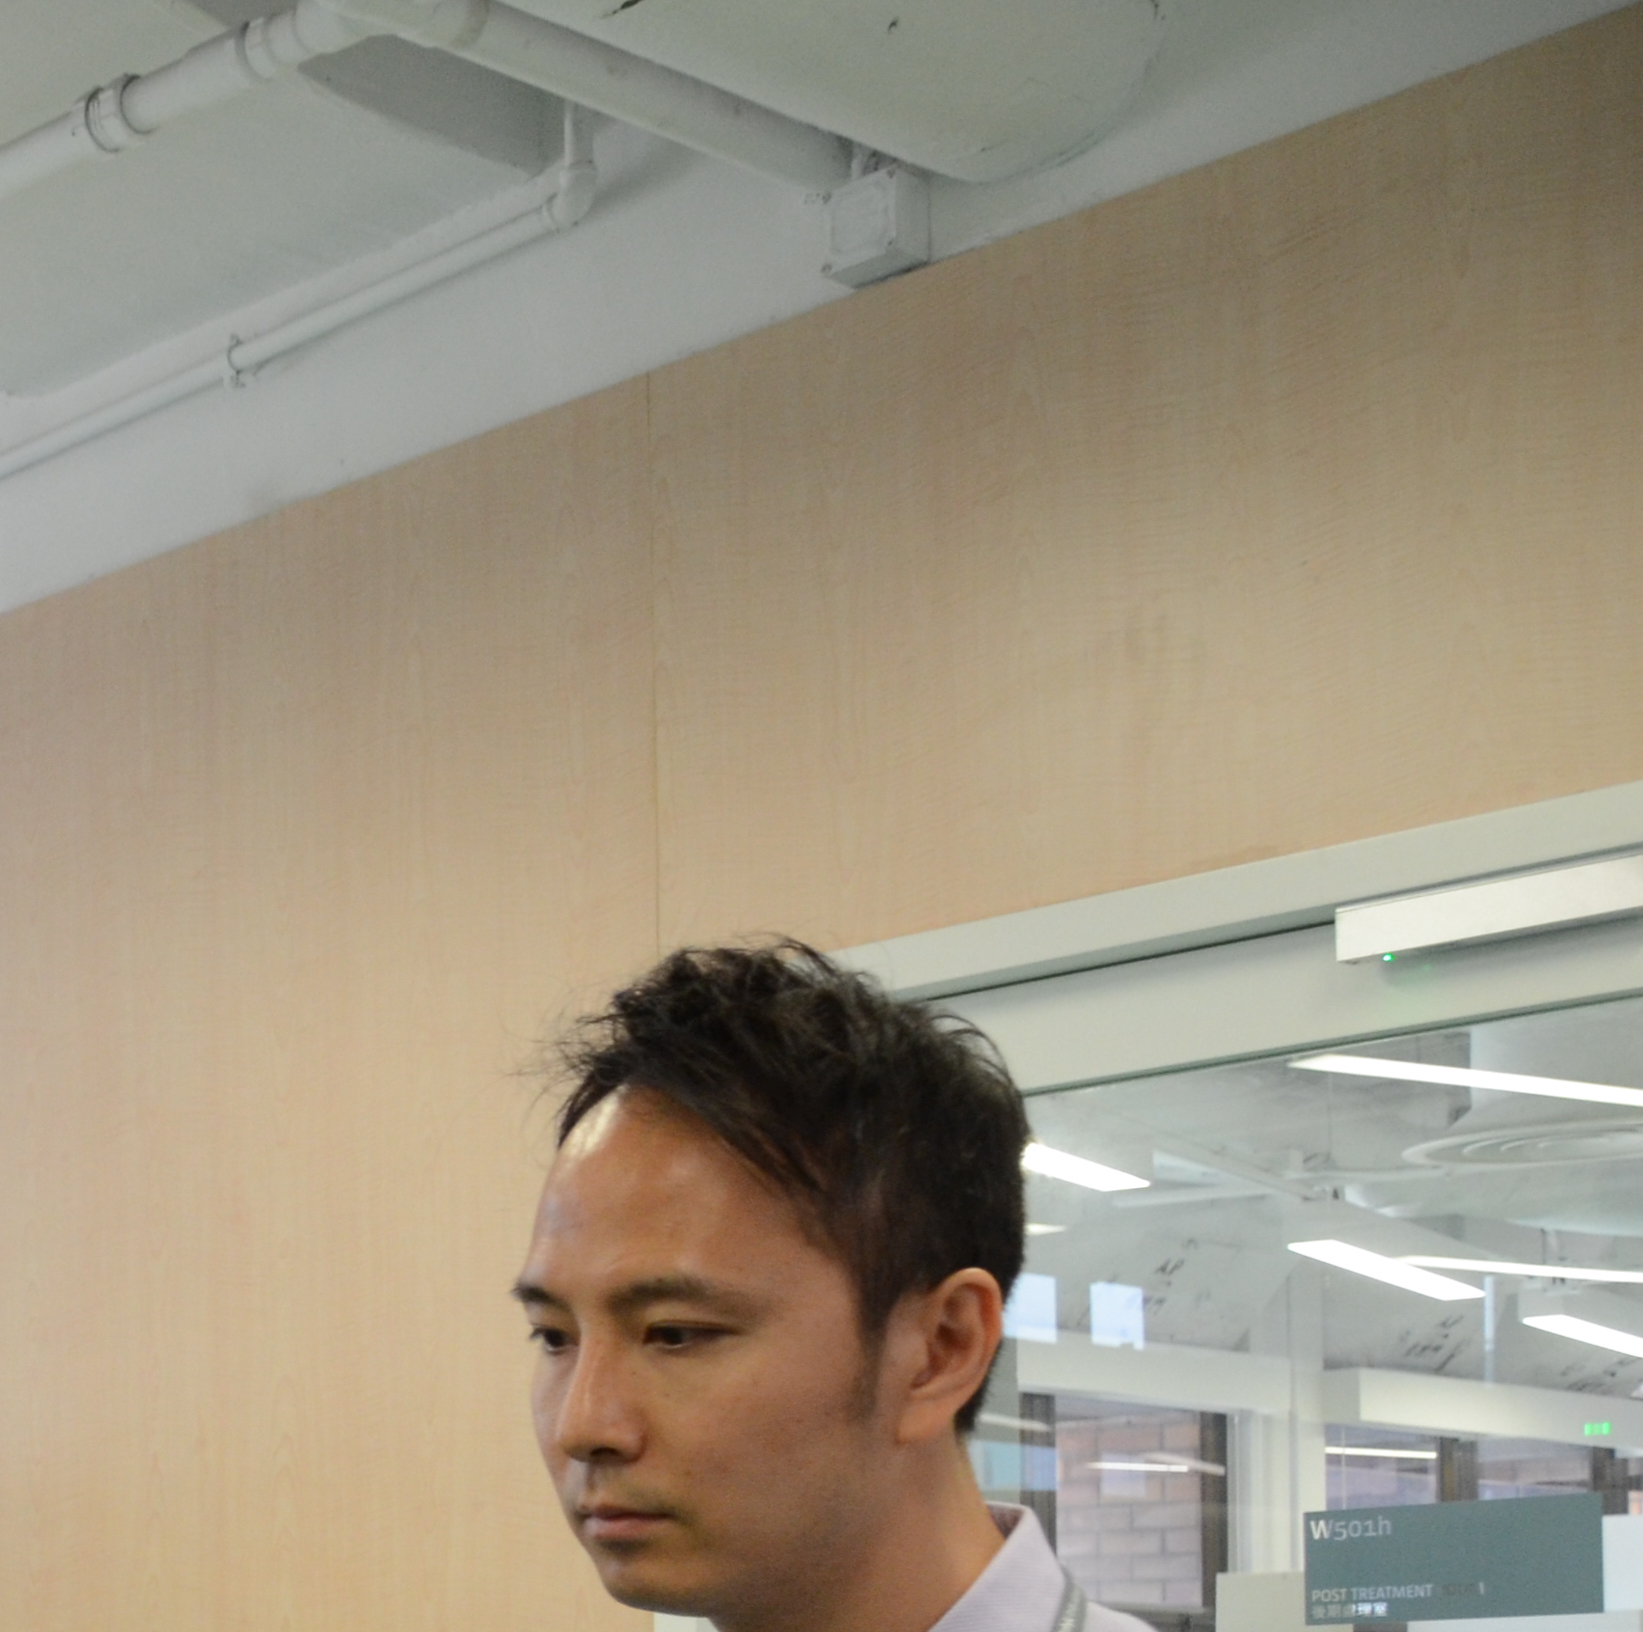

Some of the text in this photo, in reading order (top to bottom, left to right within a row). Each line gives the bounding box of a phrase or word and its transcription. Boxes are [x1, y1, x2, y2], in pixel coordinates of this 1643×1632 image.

[1310, 1515, 1392, 1541] W501h
[1312, 1588, 1347, 1602] POST
[1351, 1583, 1434, 1600] TREATMENT
